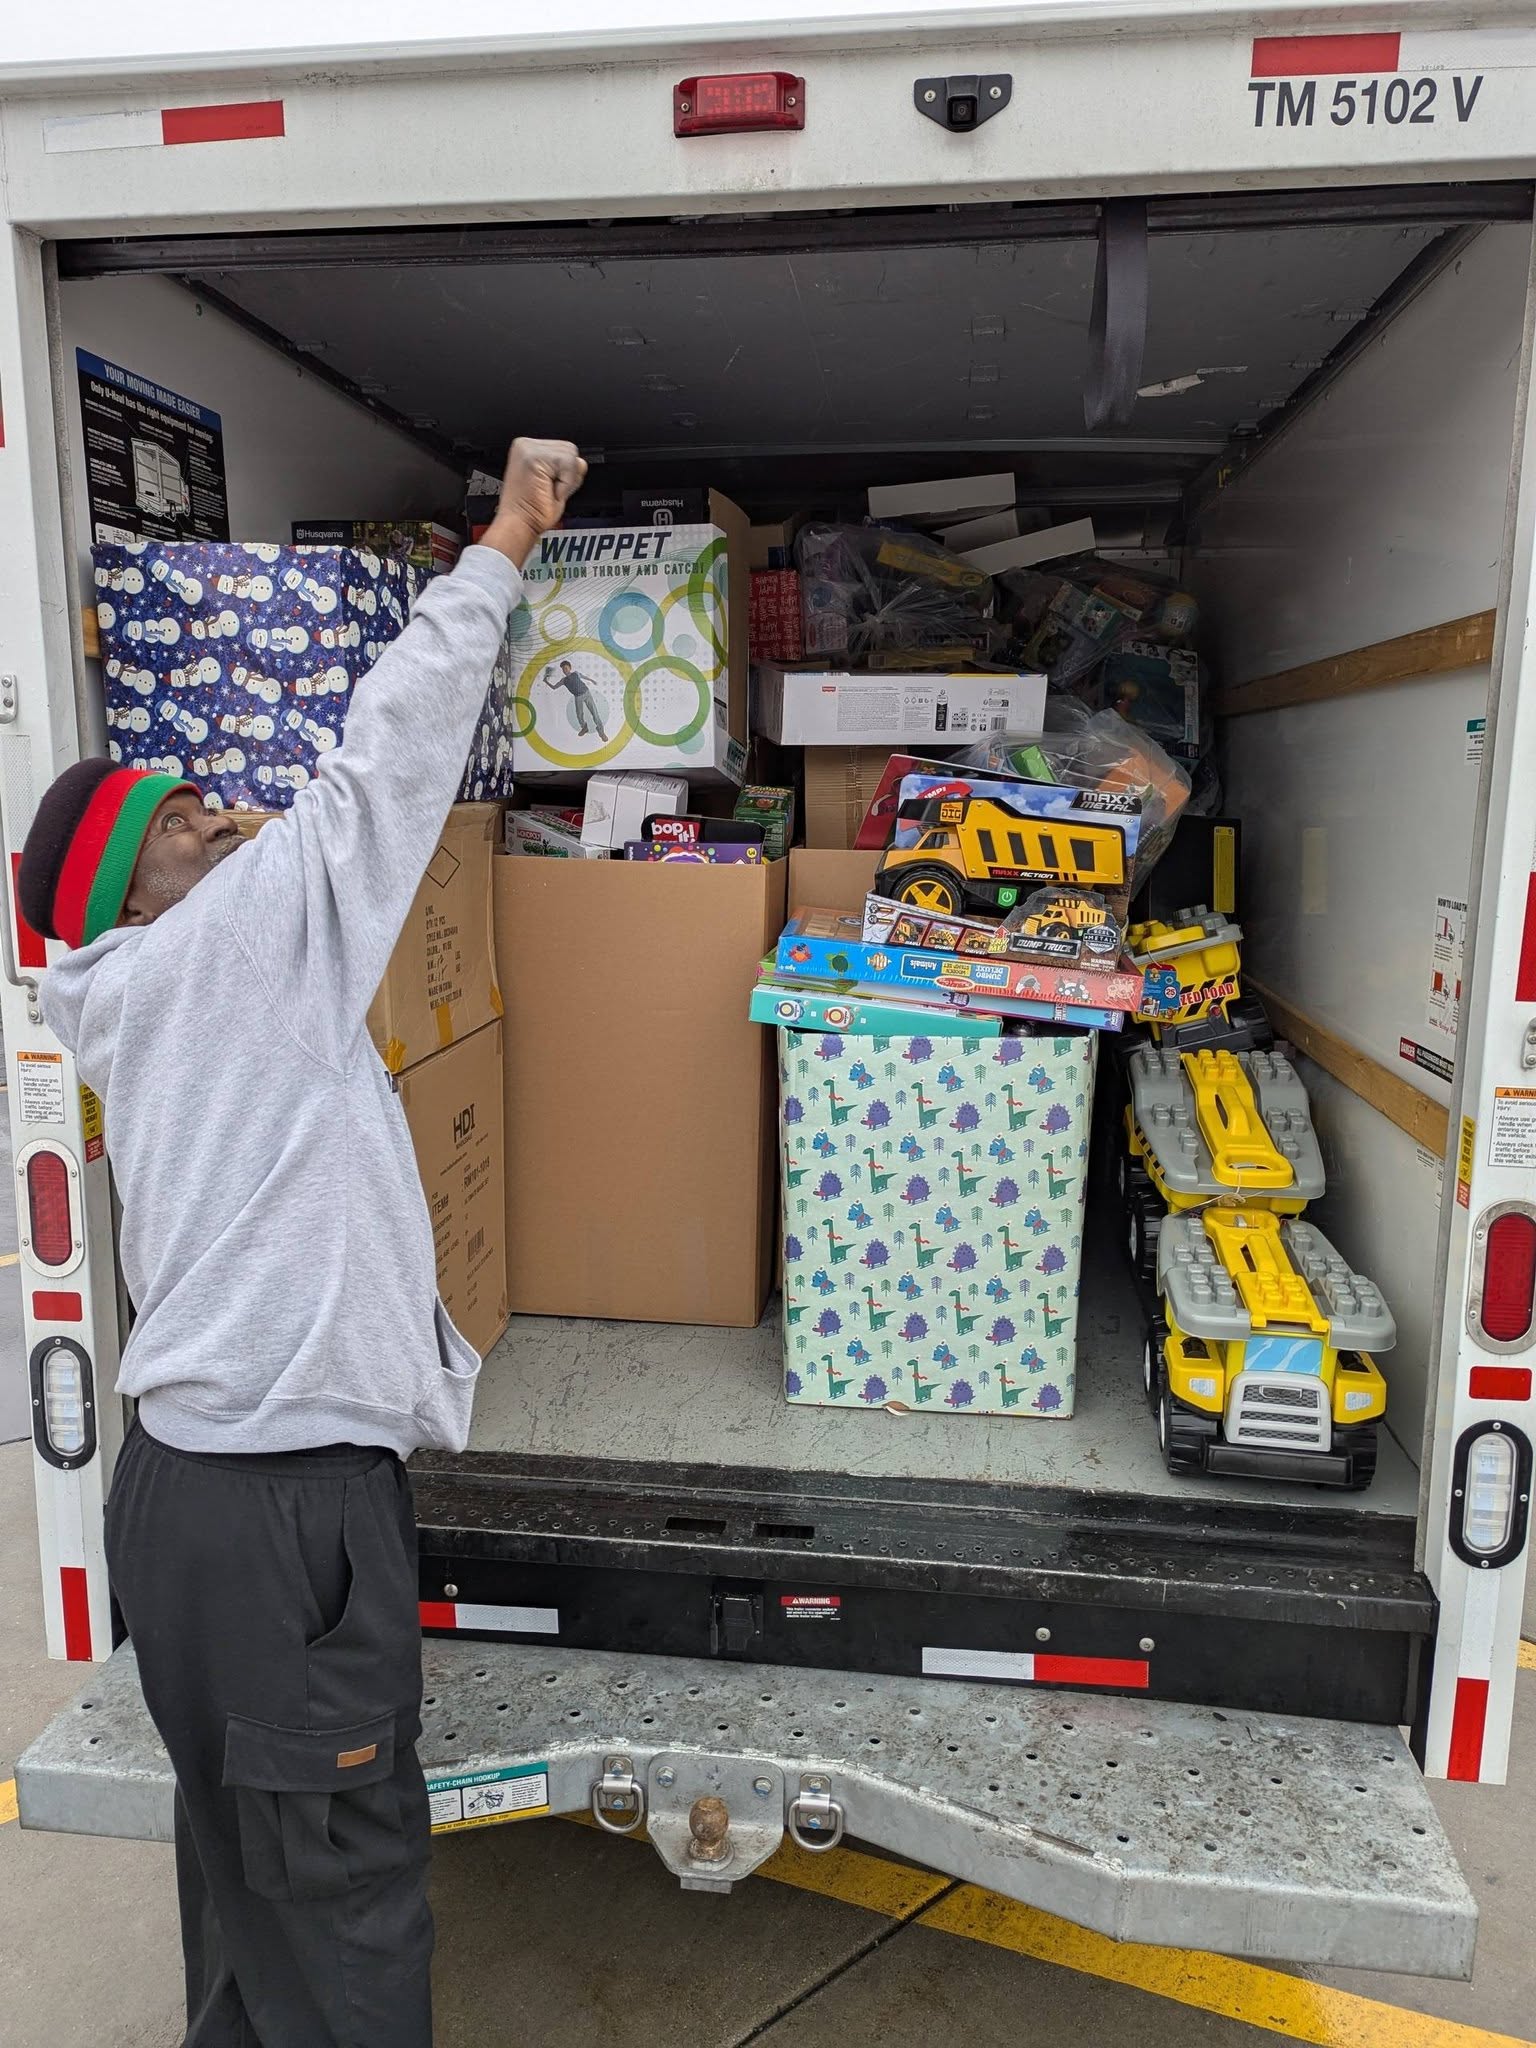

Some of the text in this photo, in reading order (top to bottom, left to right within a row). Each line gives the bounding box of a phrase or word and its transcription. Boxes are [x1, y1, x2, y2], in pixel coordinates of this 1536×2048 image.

[1247, 75, 1484, 127] TM 5102 V
[104, 364, 201, 420] YOUR MOVING MADE EASIER
[90, 380, 105, 397] Only
[105, 387, 125, 405] U-Haul
[125, 394, 136, 409] has
[146, 406, 160, 423] right
[641, 498, 684, 508] Husqvarna
[305, 529, 344, 540] Husqvarna
[540, 531, 672, 564] WHIPPET
[547, 566, 588, 580] ACTION
[592, 564, 631, 578] THROW
[636, 563, 658, 576] AND
[664, 562, 705, 575] CATCH!
[1081, 791, 1138, 806] MAXX
[1080, 801, 1134, 813] METAL
[651, 821, 684, 836] bop
[992, 869, 1054, 879] MAXX ACTION
[1088, 935, 1113, 943] METAL
[1017, 939, 1075, 953] DUMP TRUCK
[910, 959, 937, 971] Animals
[975, 965, 1004, 974] DELUXE
[976, 971, 1002, 980] JUMBO
[1203, 983, 1234, 1000] LOAD
[1513, 1089, 1536, 1097] WARNI
[453, 1103, 475, 1143] HDI
[474, 1773, 501, 1783] HOOKUP
